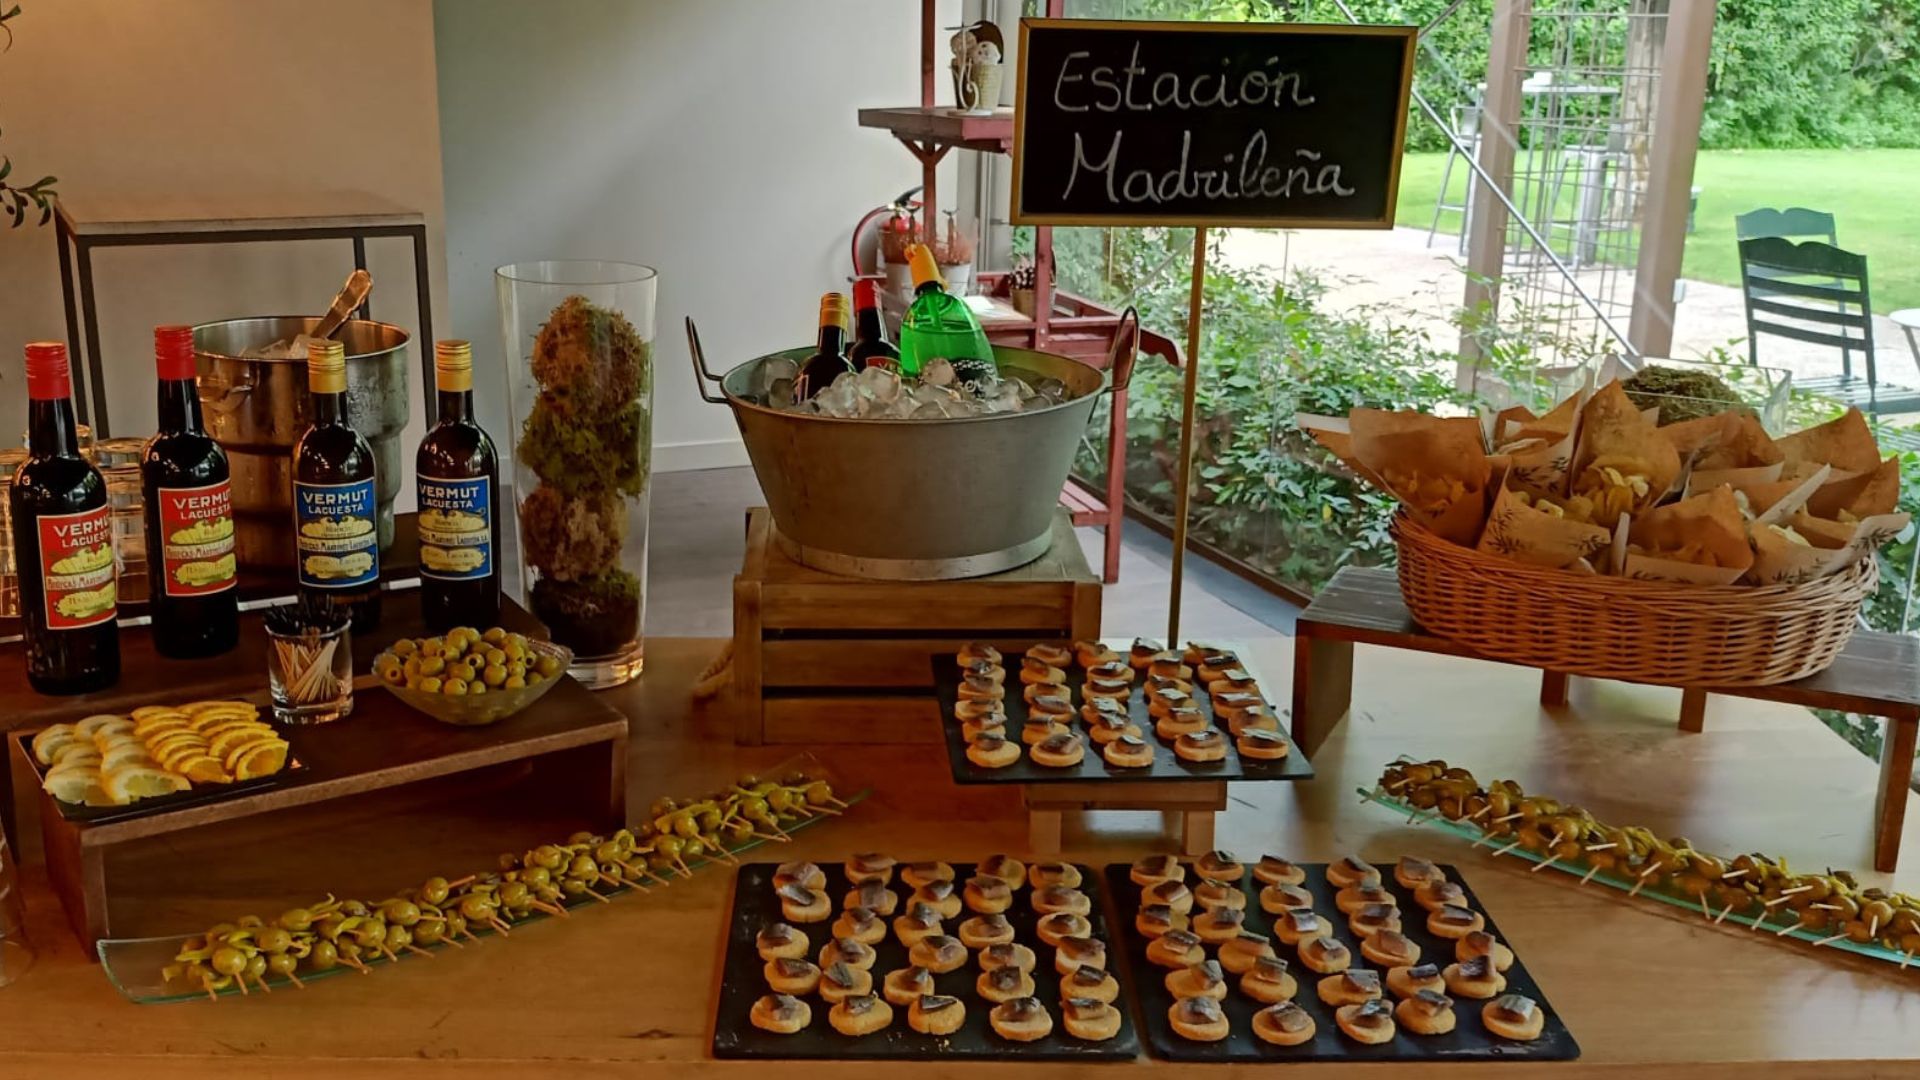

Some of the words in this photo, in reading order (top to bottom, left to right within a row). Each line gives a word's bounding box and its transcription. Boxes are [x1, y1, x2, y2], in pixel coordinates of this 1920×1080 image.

[1055, 40, 1315, 111] Estación
[1062, 129, 1355, 203] Madrileña
[302, 489, 368, 505] VERMUT
[418, 483, 480, 499] VERMUT
[308, 503, 364, 515] LACUESTA
[422, 498, 474, 509] LACUESTA
